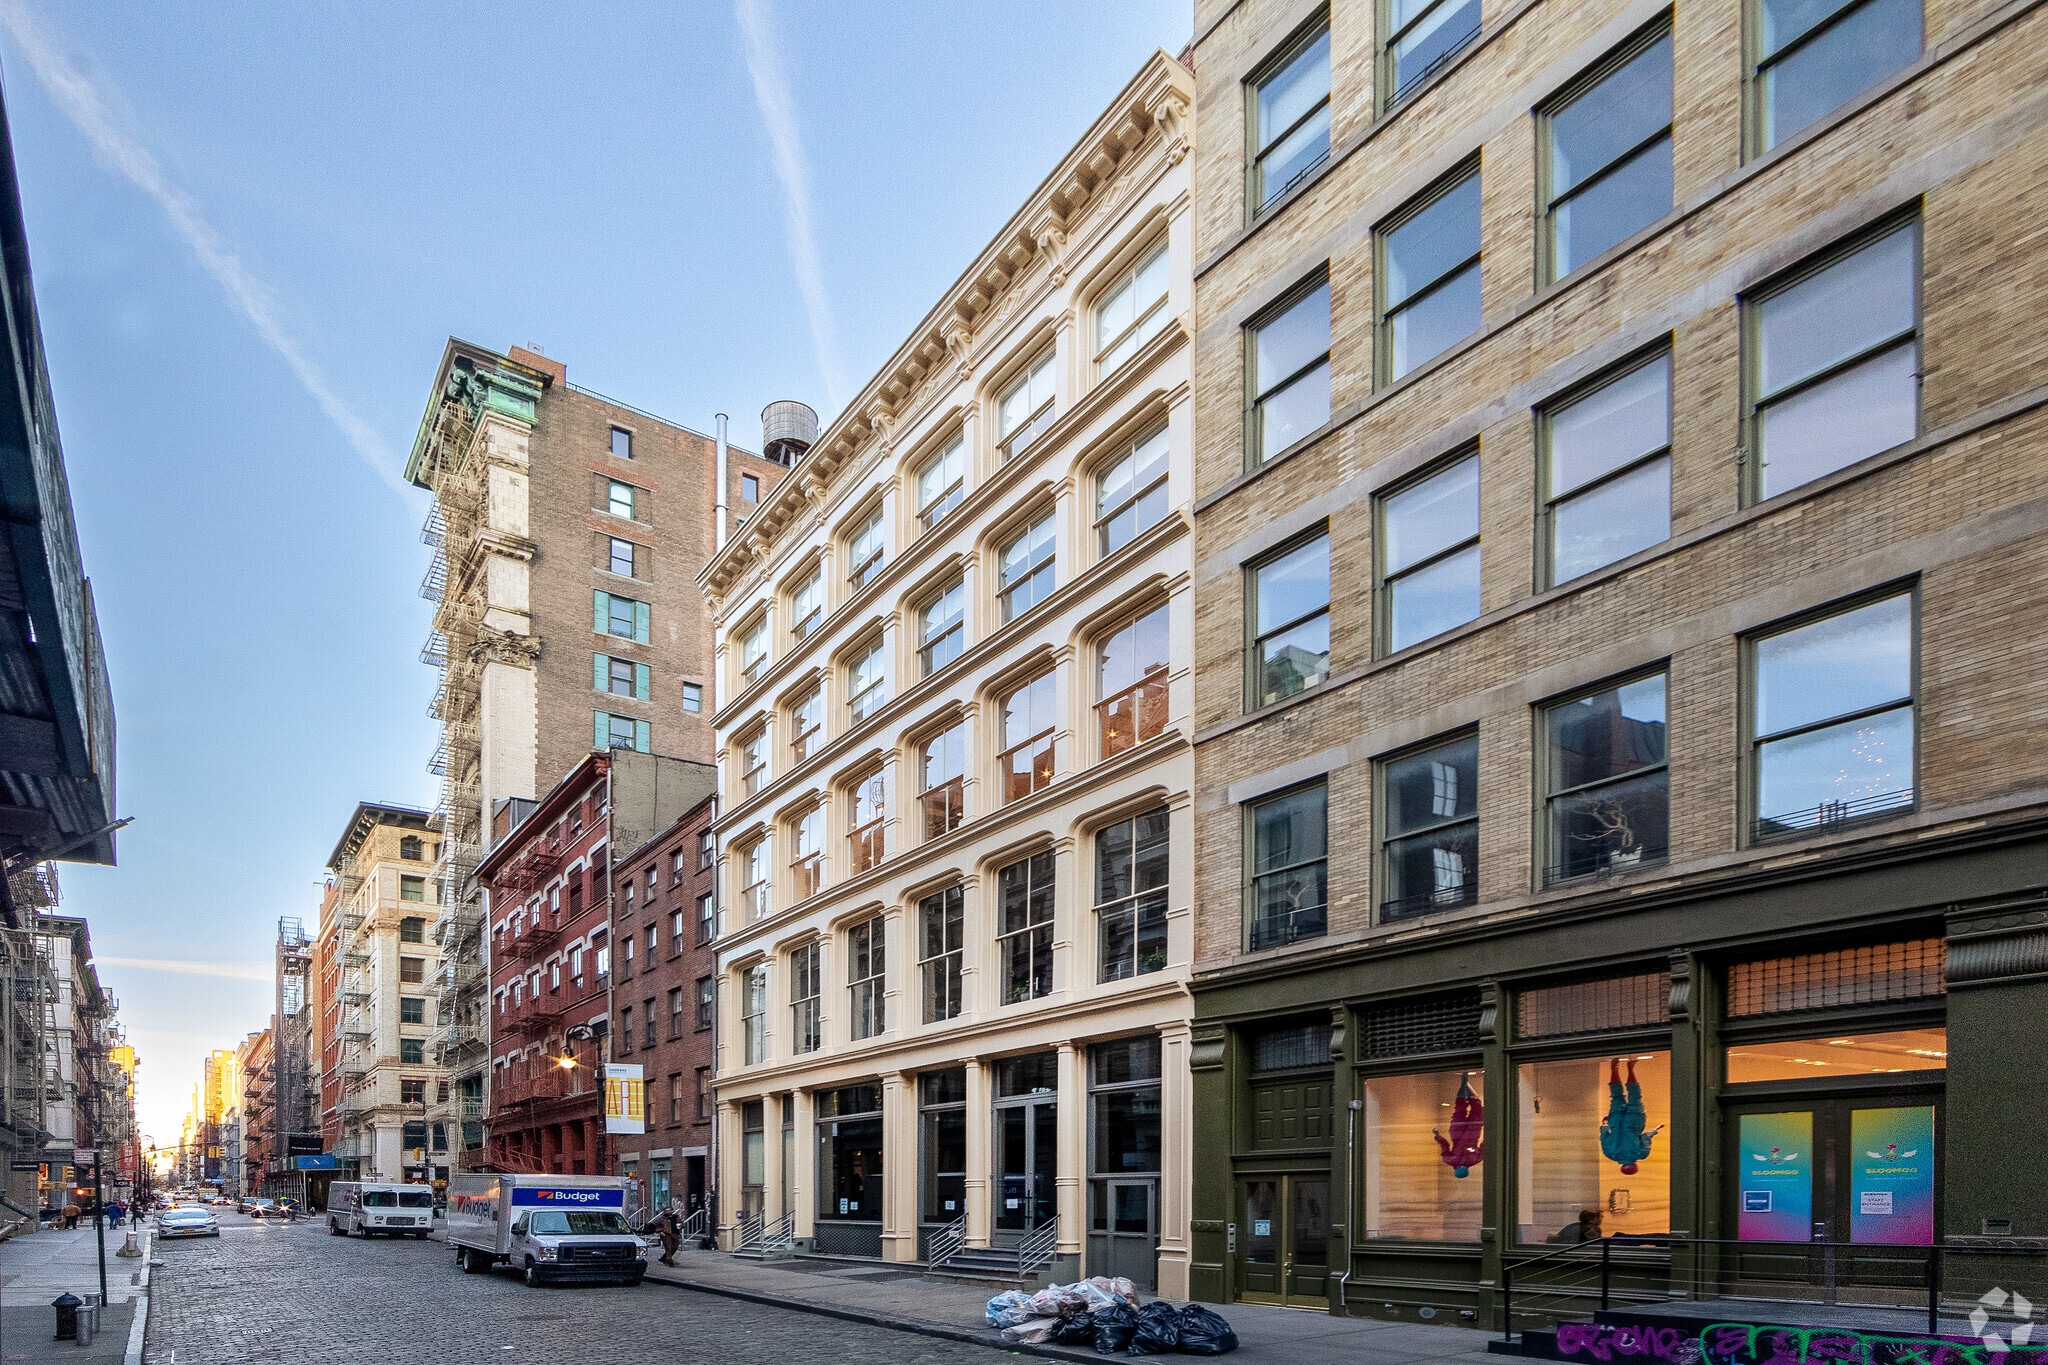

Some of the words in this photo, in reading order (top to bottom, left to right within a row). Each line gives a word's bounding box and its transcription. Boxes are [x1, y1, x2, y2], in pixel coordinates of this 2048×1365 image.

[607, 1080, 641, 1115] ART
[555, 1191, 600, 1202] Budget
[465, 1197, 491, 1221] Budget
